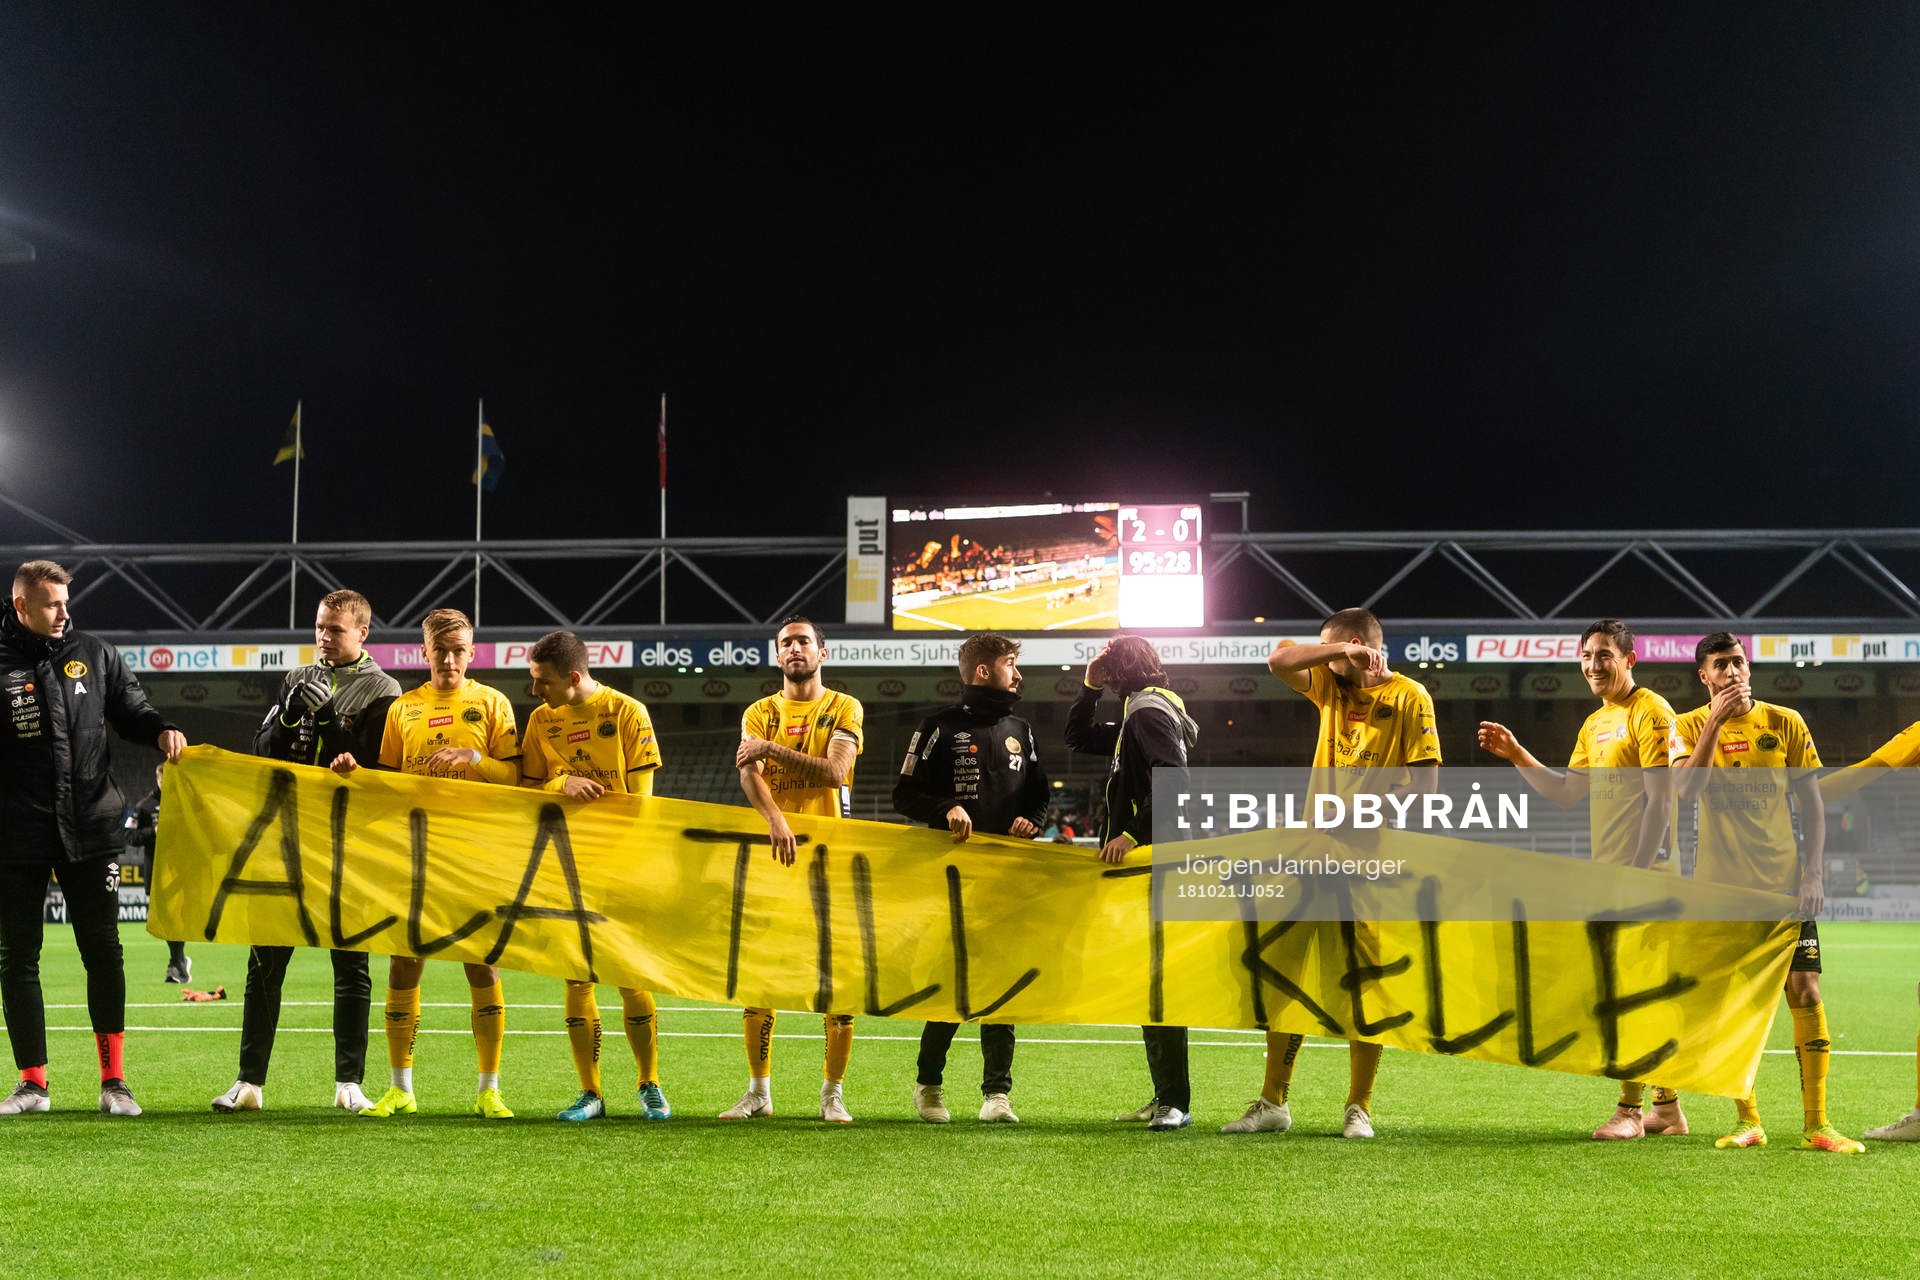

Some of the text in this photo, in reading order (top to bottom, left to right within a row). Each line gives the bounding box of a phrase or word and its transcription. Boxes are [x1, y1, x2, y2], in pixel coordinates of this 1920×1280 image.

[1132, 520, 1147, 542] 2
[1173, 520, 1188, 542] 0
[1129, 551, 1192, 573] 95:28
[641, 642, 693, 667] ellos
[709, 642, 761, 666] ellos
[1191, 640, 1271, 662] Sjuhärad
[1405, 636, 1458, 661] ellos
[75, 682, 88, 695] A
[12, 696, 36, 708] ellos
[954, 755, 977, 766] ellos
[1009, 755, 1022, 772] 27
[204, 768, 608, 982] ALLA
[683, 827, 1040, 1021] TILL
[760, 1014, 775, 1061] FRISTADS
